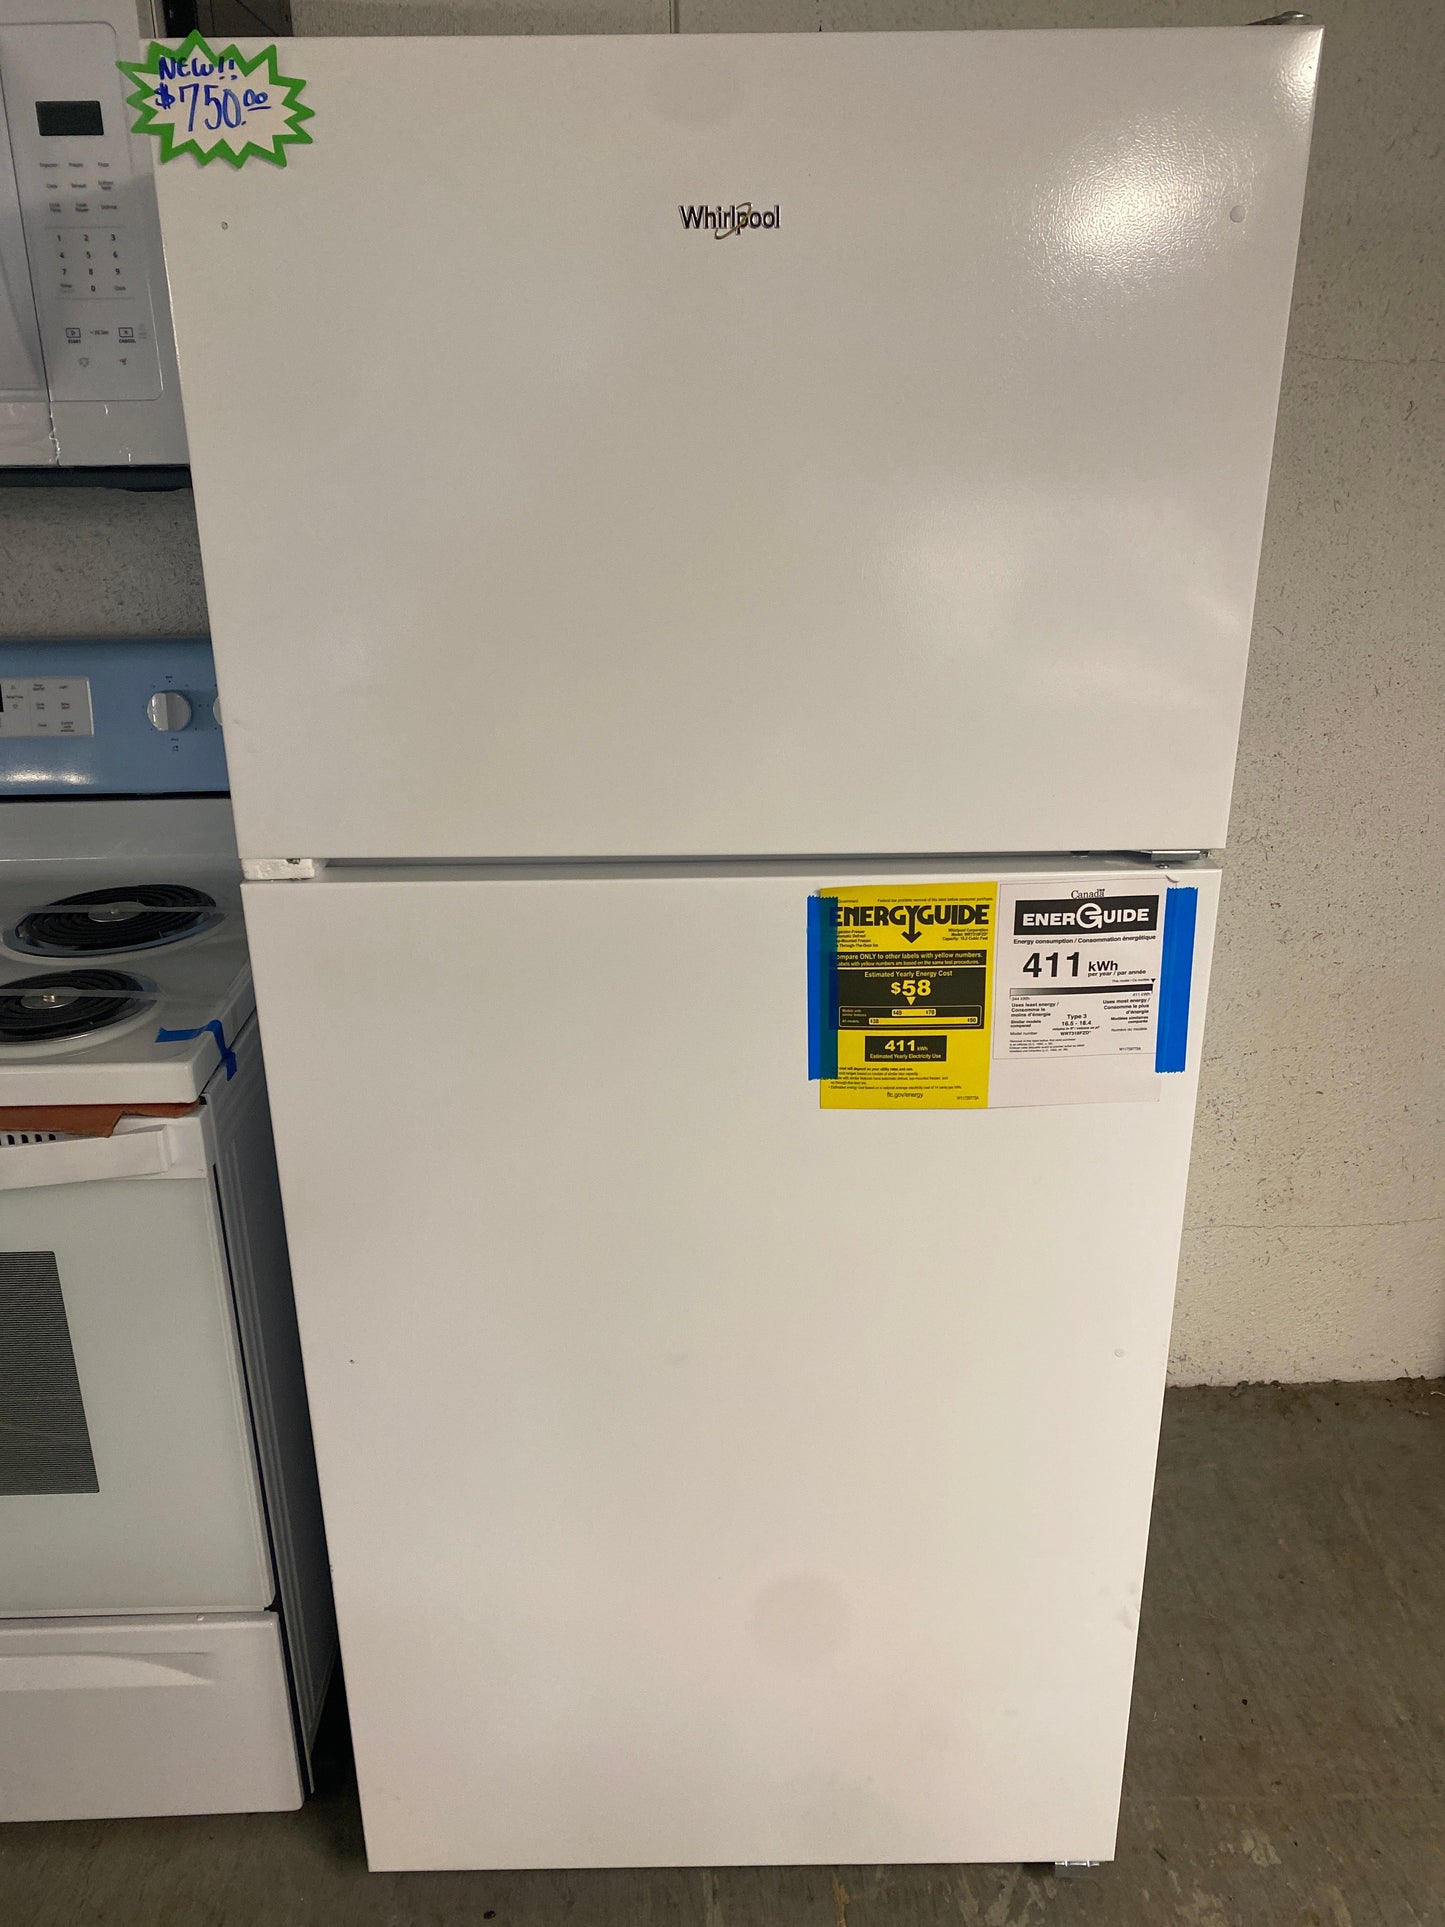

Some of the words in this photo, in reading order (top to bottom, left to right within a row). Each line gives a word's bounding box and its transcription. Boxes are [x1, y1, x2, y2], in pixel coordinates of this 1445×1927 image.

[159, 56, 237, 80] NEW!!
[679, 204, 780, 236] Whirlpool
[57, 234, 62, 242] 1
[83, 234, 89, 242] 2
[86, 251, 91, 259] 5
[1022, 902, 1150, 929] ENERGUIDE
[1122, 934, 1156, 942] énergétique
[1022, 951, 1080, 978] 411
[1088, 961, 1118, 972] kWh
[915, 970, 937, 978] Energy
[890, 979, 931, 997] $58
[884, 1039, 915, 1051] 411
